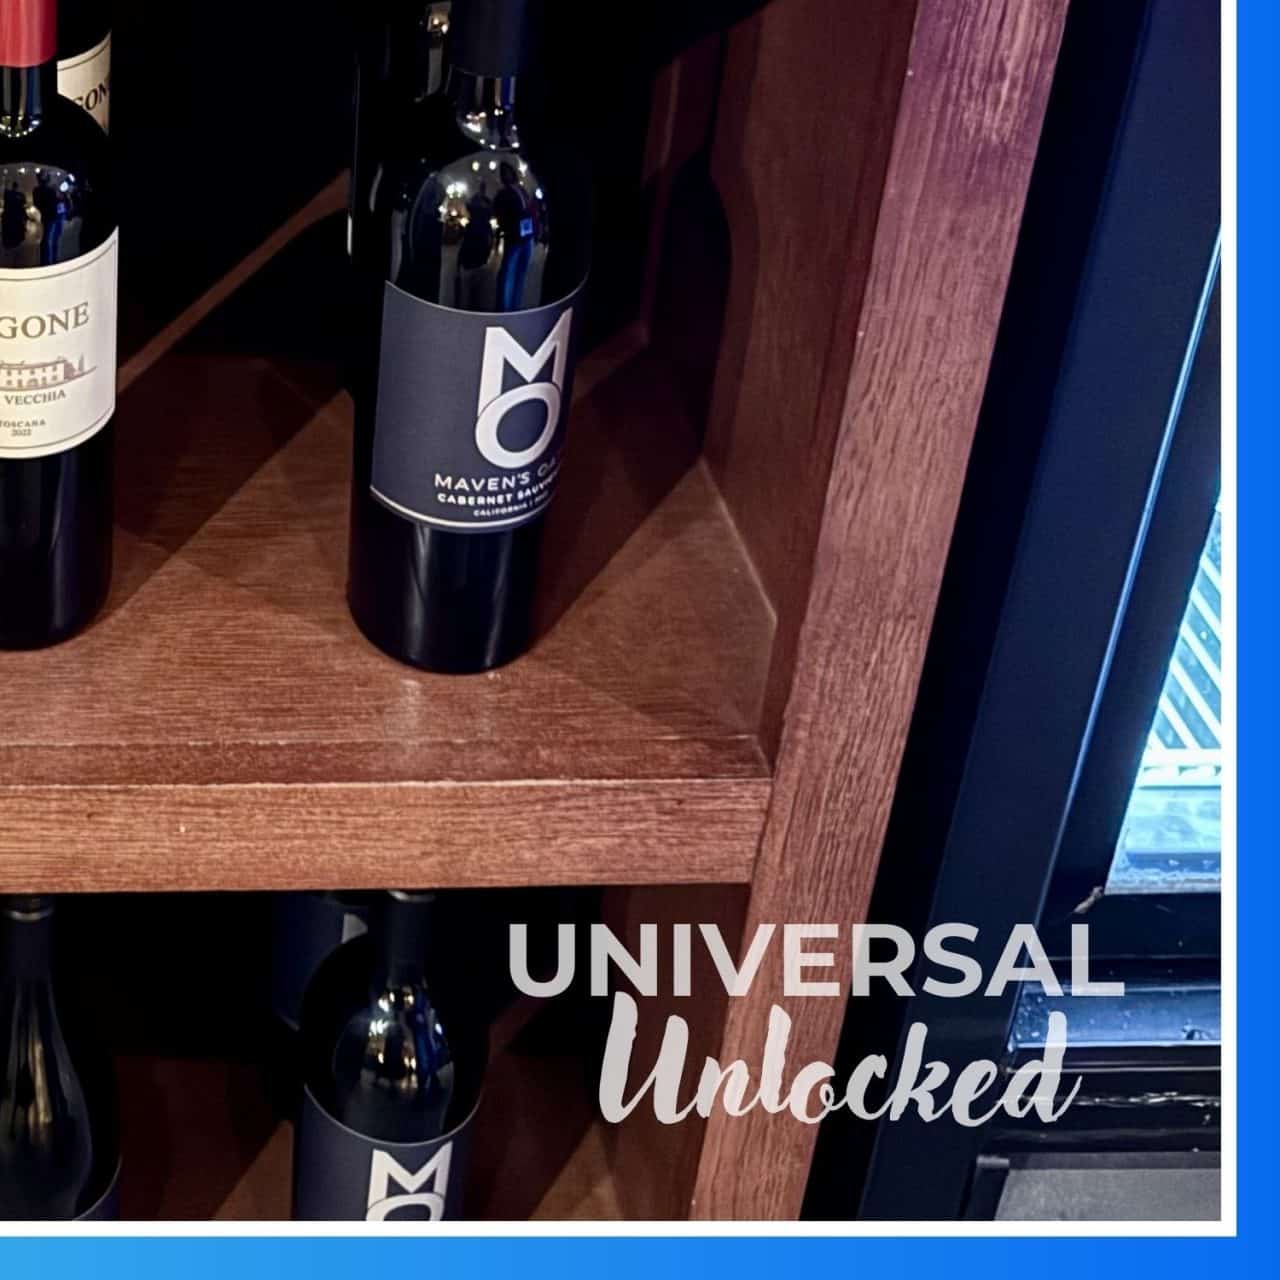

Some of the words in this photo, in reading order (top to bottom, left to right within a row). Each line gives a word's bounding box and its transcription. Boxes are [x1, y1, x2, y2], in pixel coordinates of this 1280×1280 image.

[3, 388, 68, 406] VECCHIA
[434, 471, 531, 492] MAVEN'S
[437, 492, 514, 507] CABERNET
